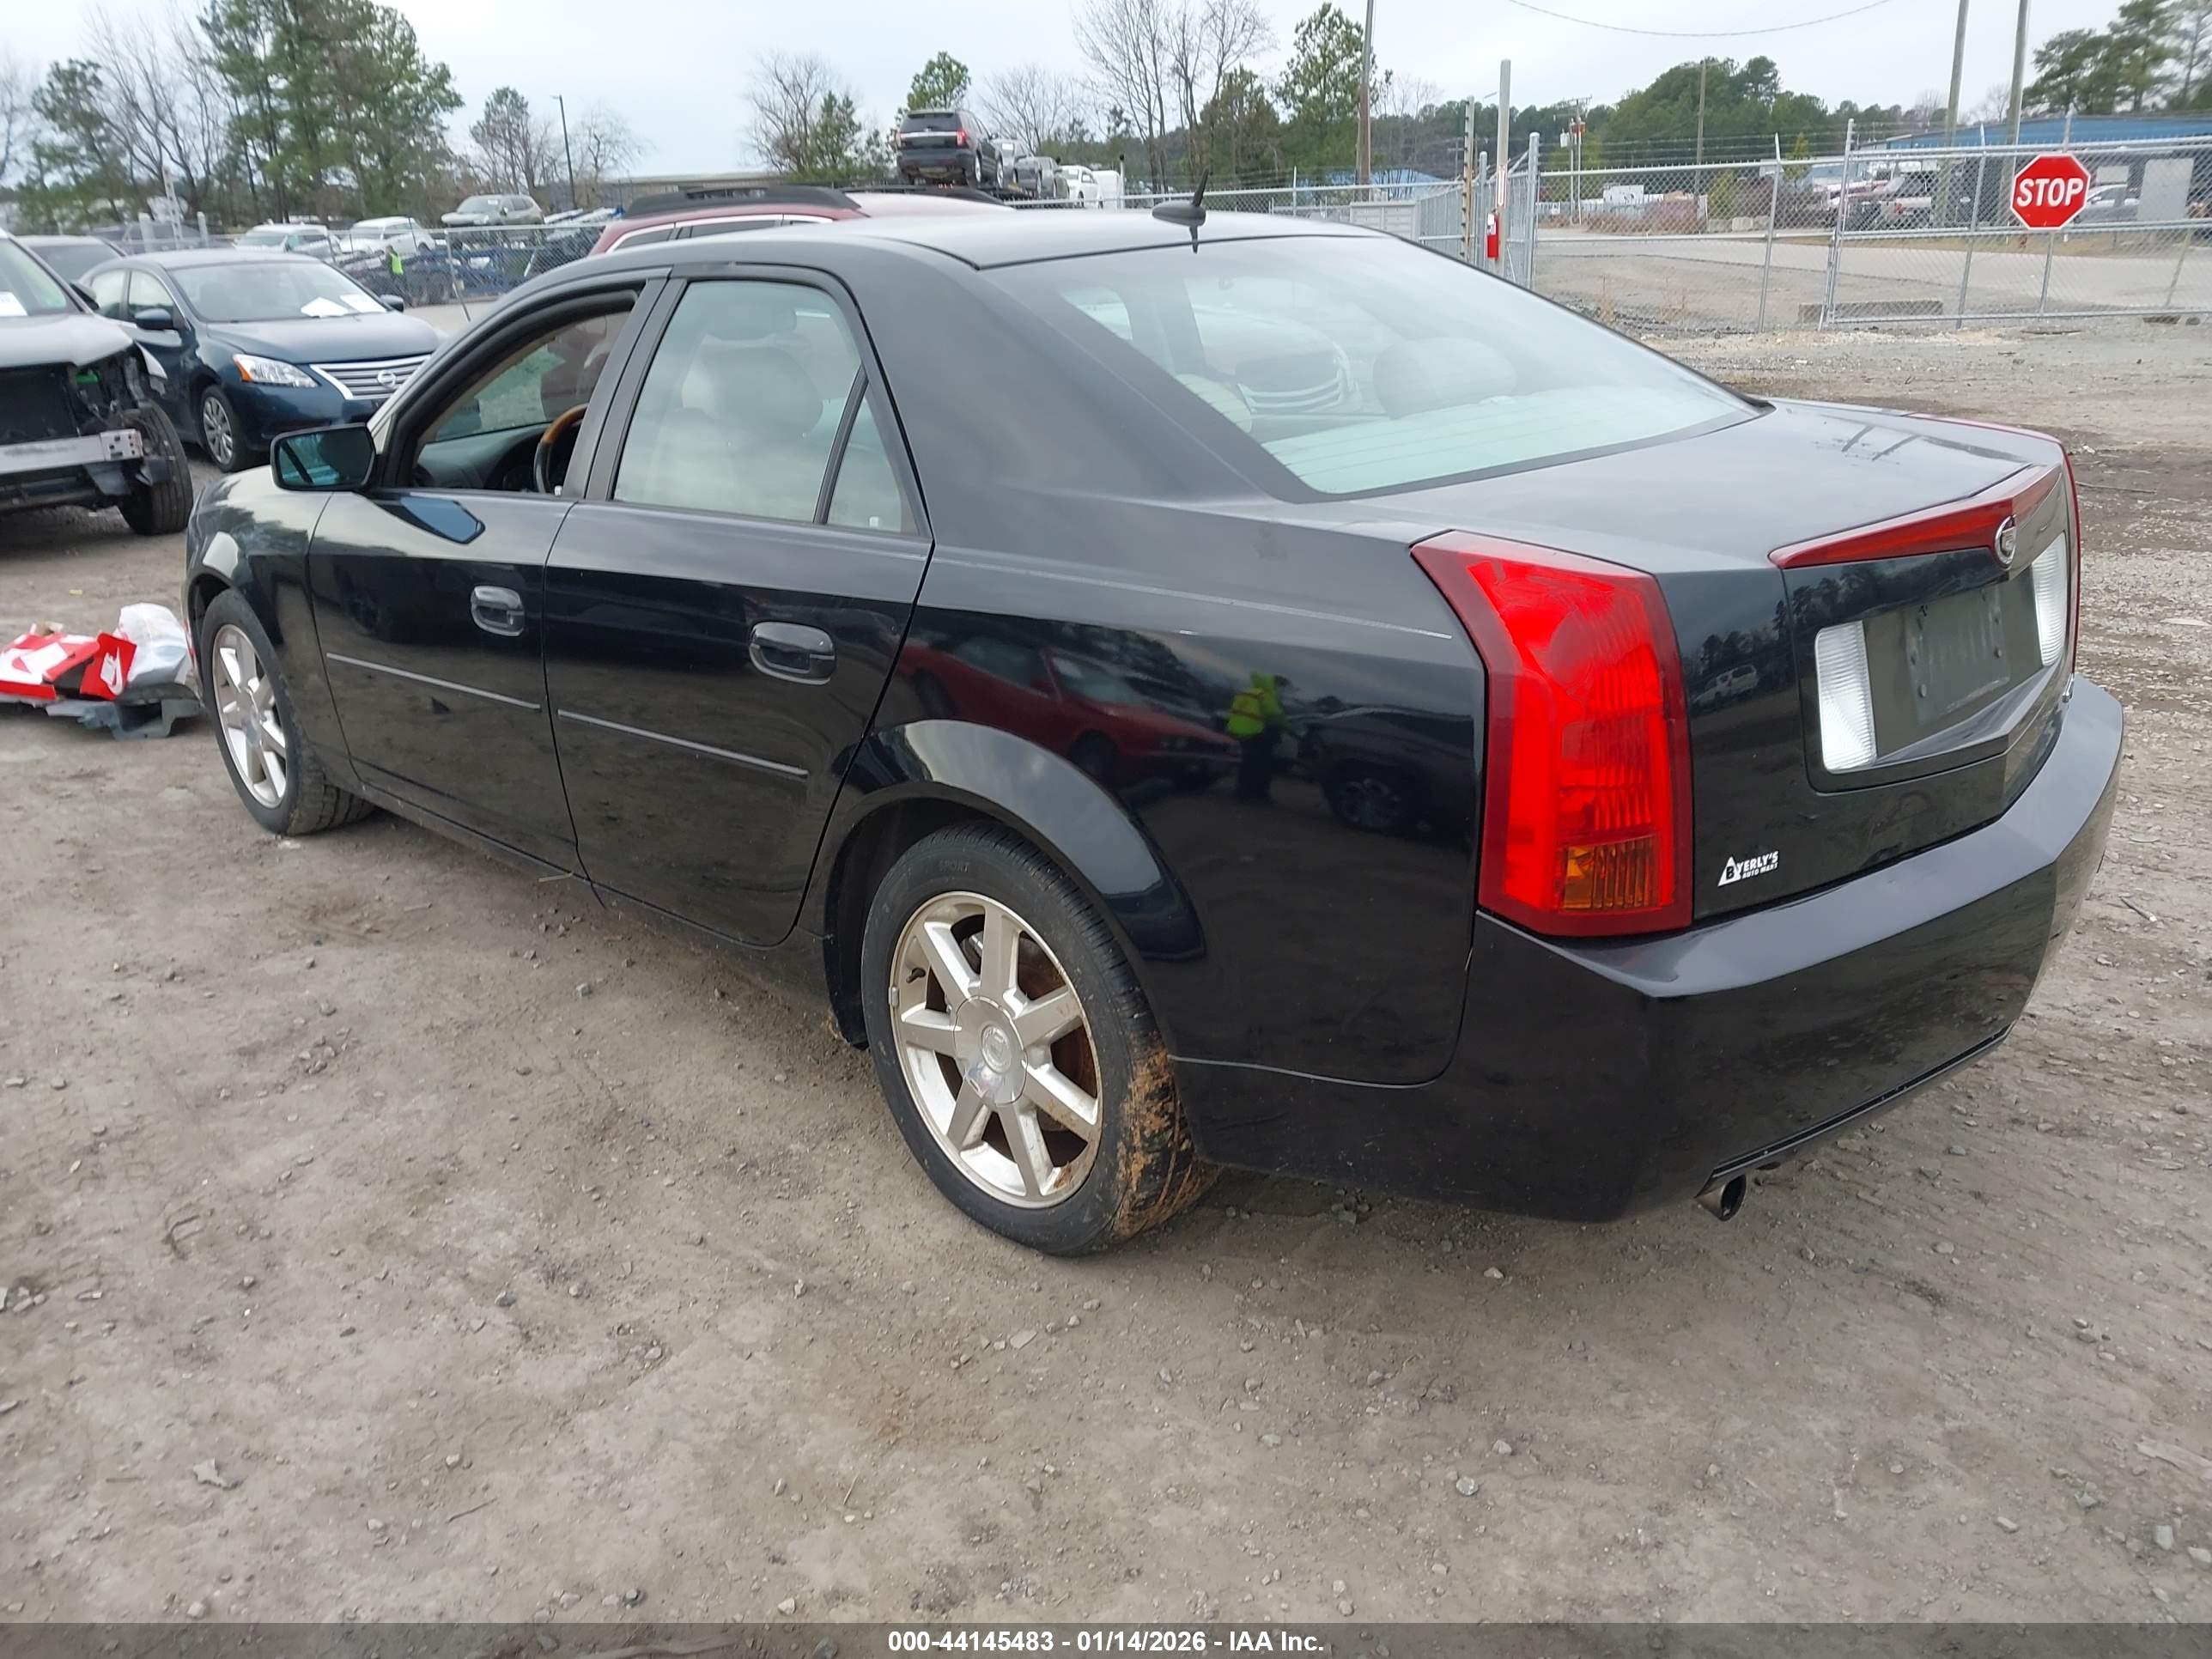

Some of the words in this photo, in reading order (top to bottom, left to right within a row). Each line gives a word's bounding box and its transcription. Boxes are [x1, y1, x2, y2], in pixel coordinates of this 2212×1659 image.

[2016, 177, 2084, 207] STOP
[1741, 868, 1759, 879] AUTO
[1759, 862, 1778, 873] MART
